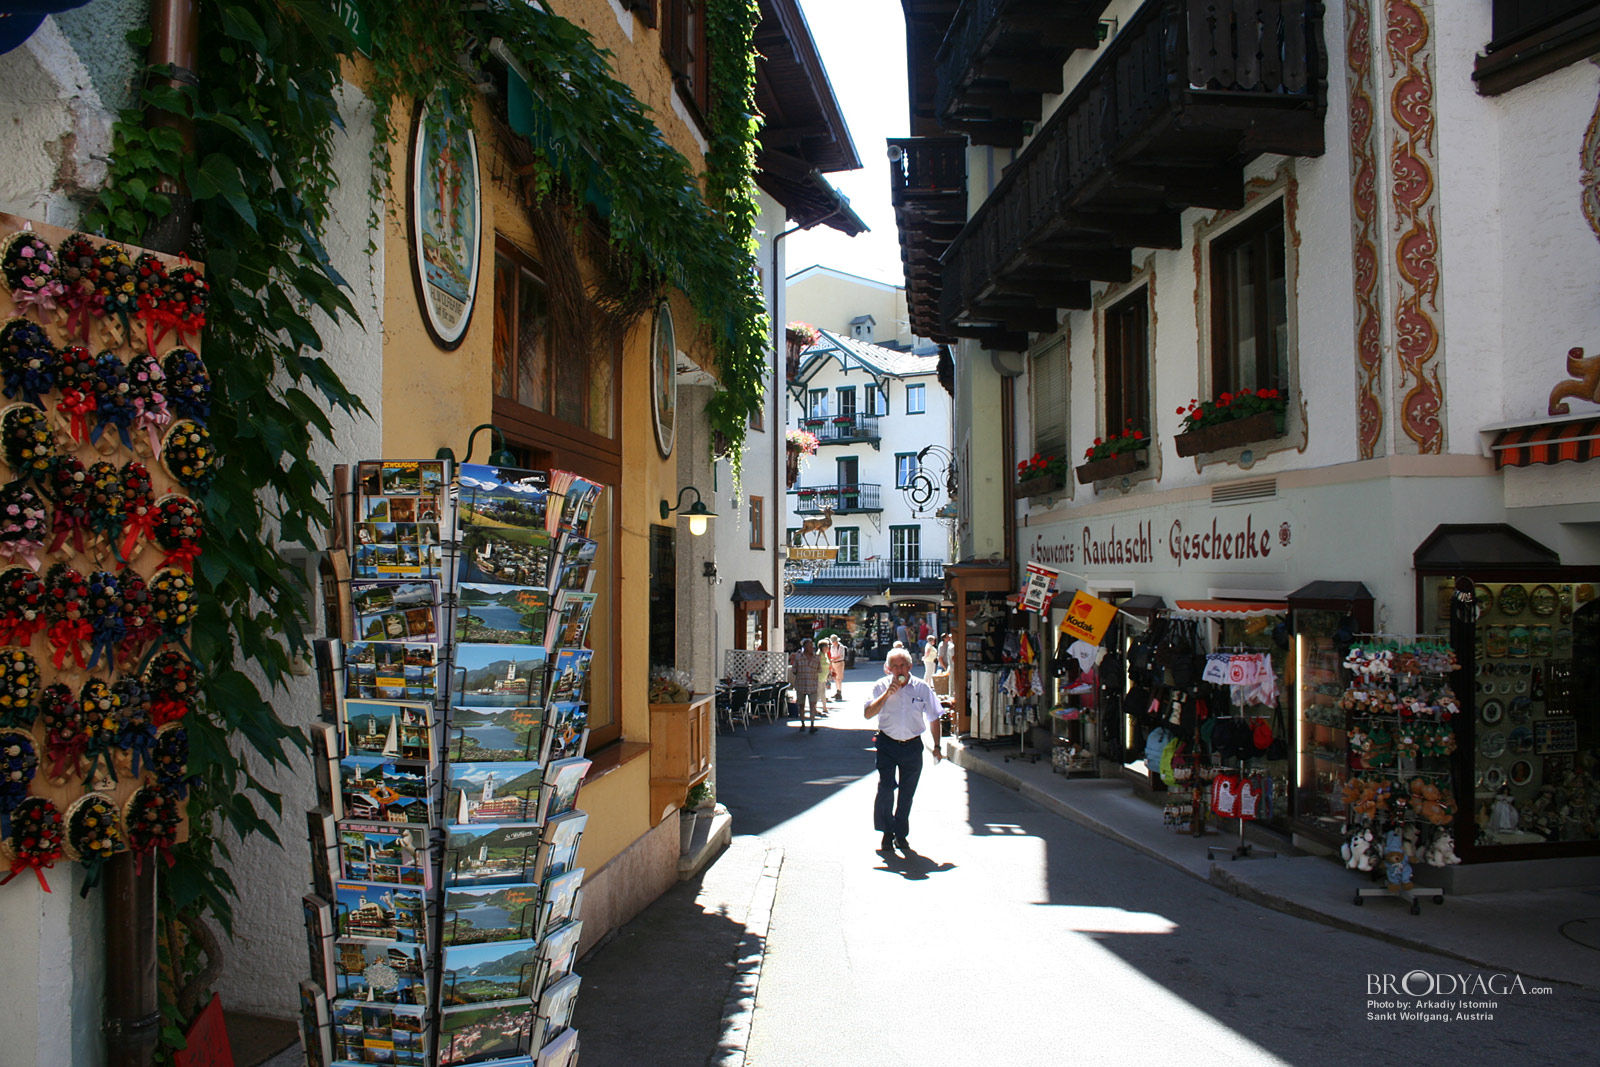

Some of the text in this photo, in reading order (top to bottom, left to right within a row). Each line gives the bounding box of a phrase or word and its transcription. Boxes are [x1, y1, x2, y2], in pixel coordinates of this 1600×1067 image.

[1036, 534, 1075, 564] Souvenirs
[1168, 513, 1272, 567] Geschenke
[796, 549, 828, 559] HOTEL
[1066, 614, 1095, 633] Kodak
